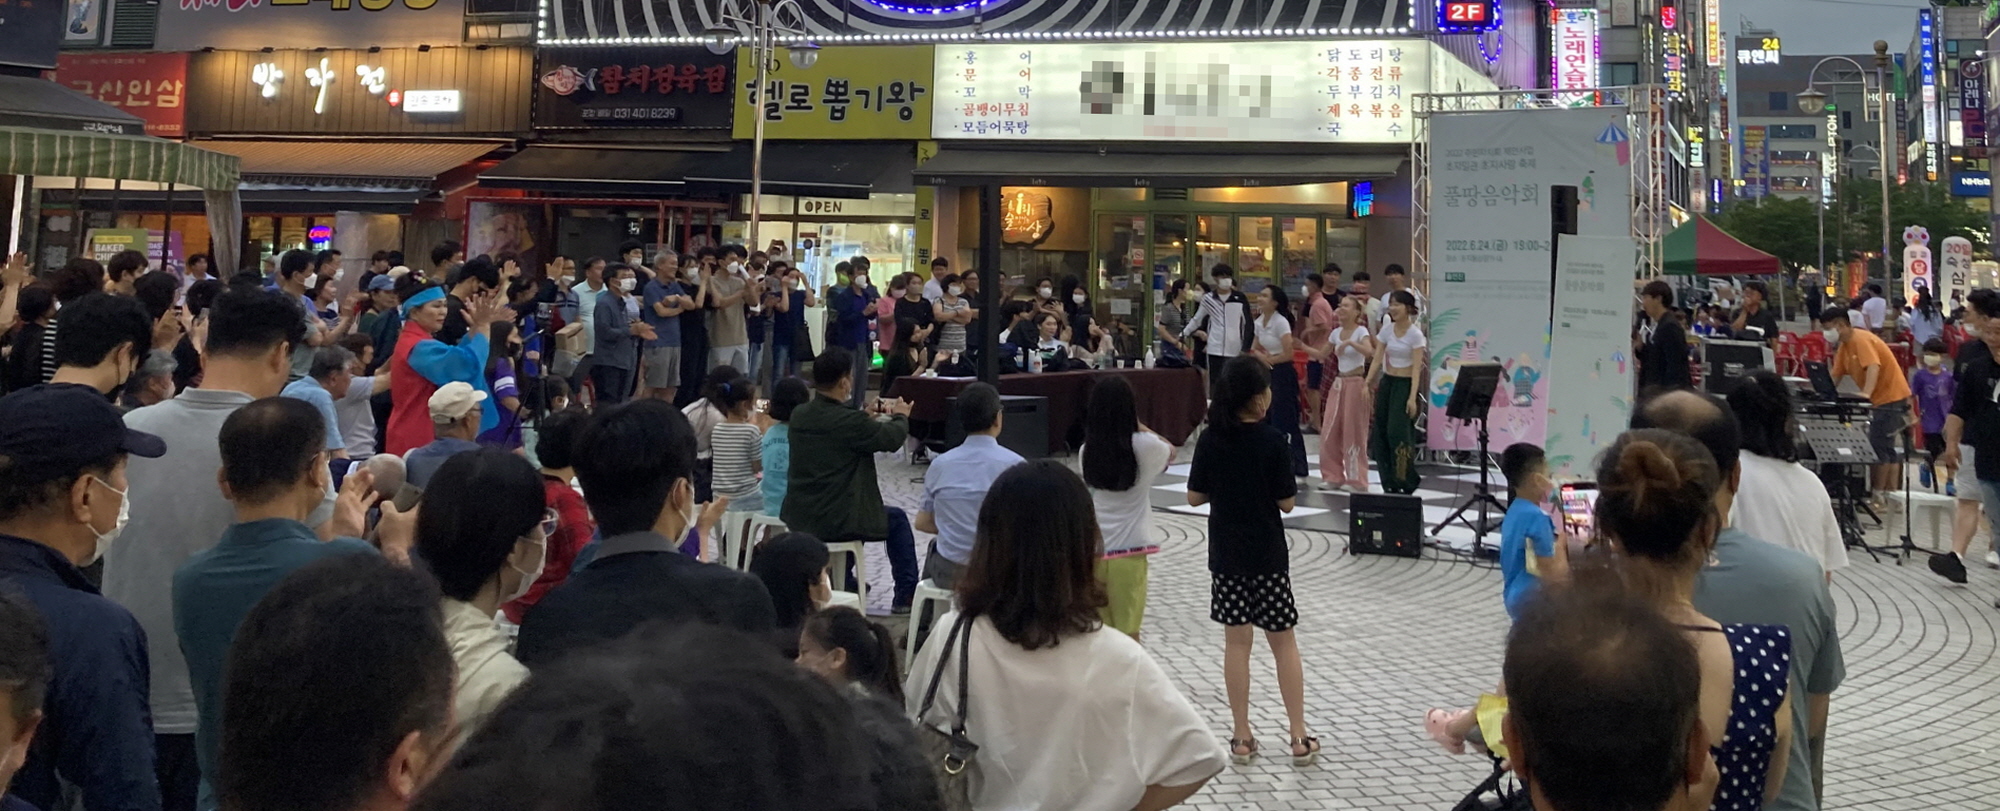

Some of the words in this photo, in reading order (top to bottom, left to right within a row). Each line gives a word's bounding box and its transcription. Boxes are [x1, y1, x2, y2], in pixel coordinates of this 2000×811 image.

[1450, 4, 1481, 19] 2F
[1762, 38, 1779, 50] 24
[1563, 27, 1588, 97] 노래연습장
[600, 64, 727, 94] 참치정육점
[1965, 79, 1979, 109] 아레나
[962, 102, 1029, 116] 골뱅이무침
[1443, 184, 1539, 207] 풀땅음악회
[805, 201, 842, 213] OPEN
[95, 244, 125, 252] BAKED
[1946, 243, 1971, 256] 20일
